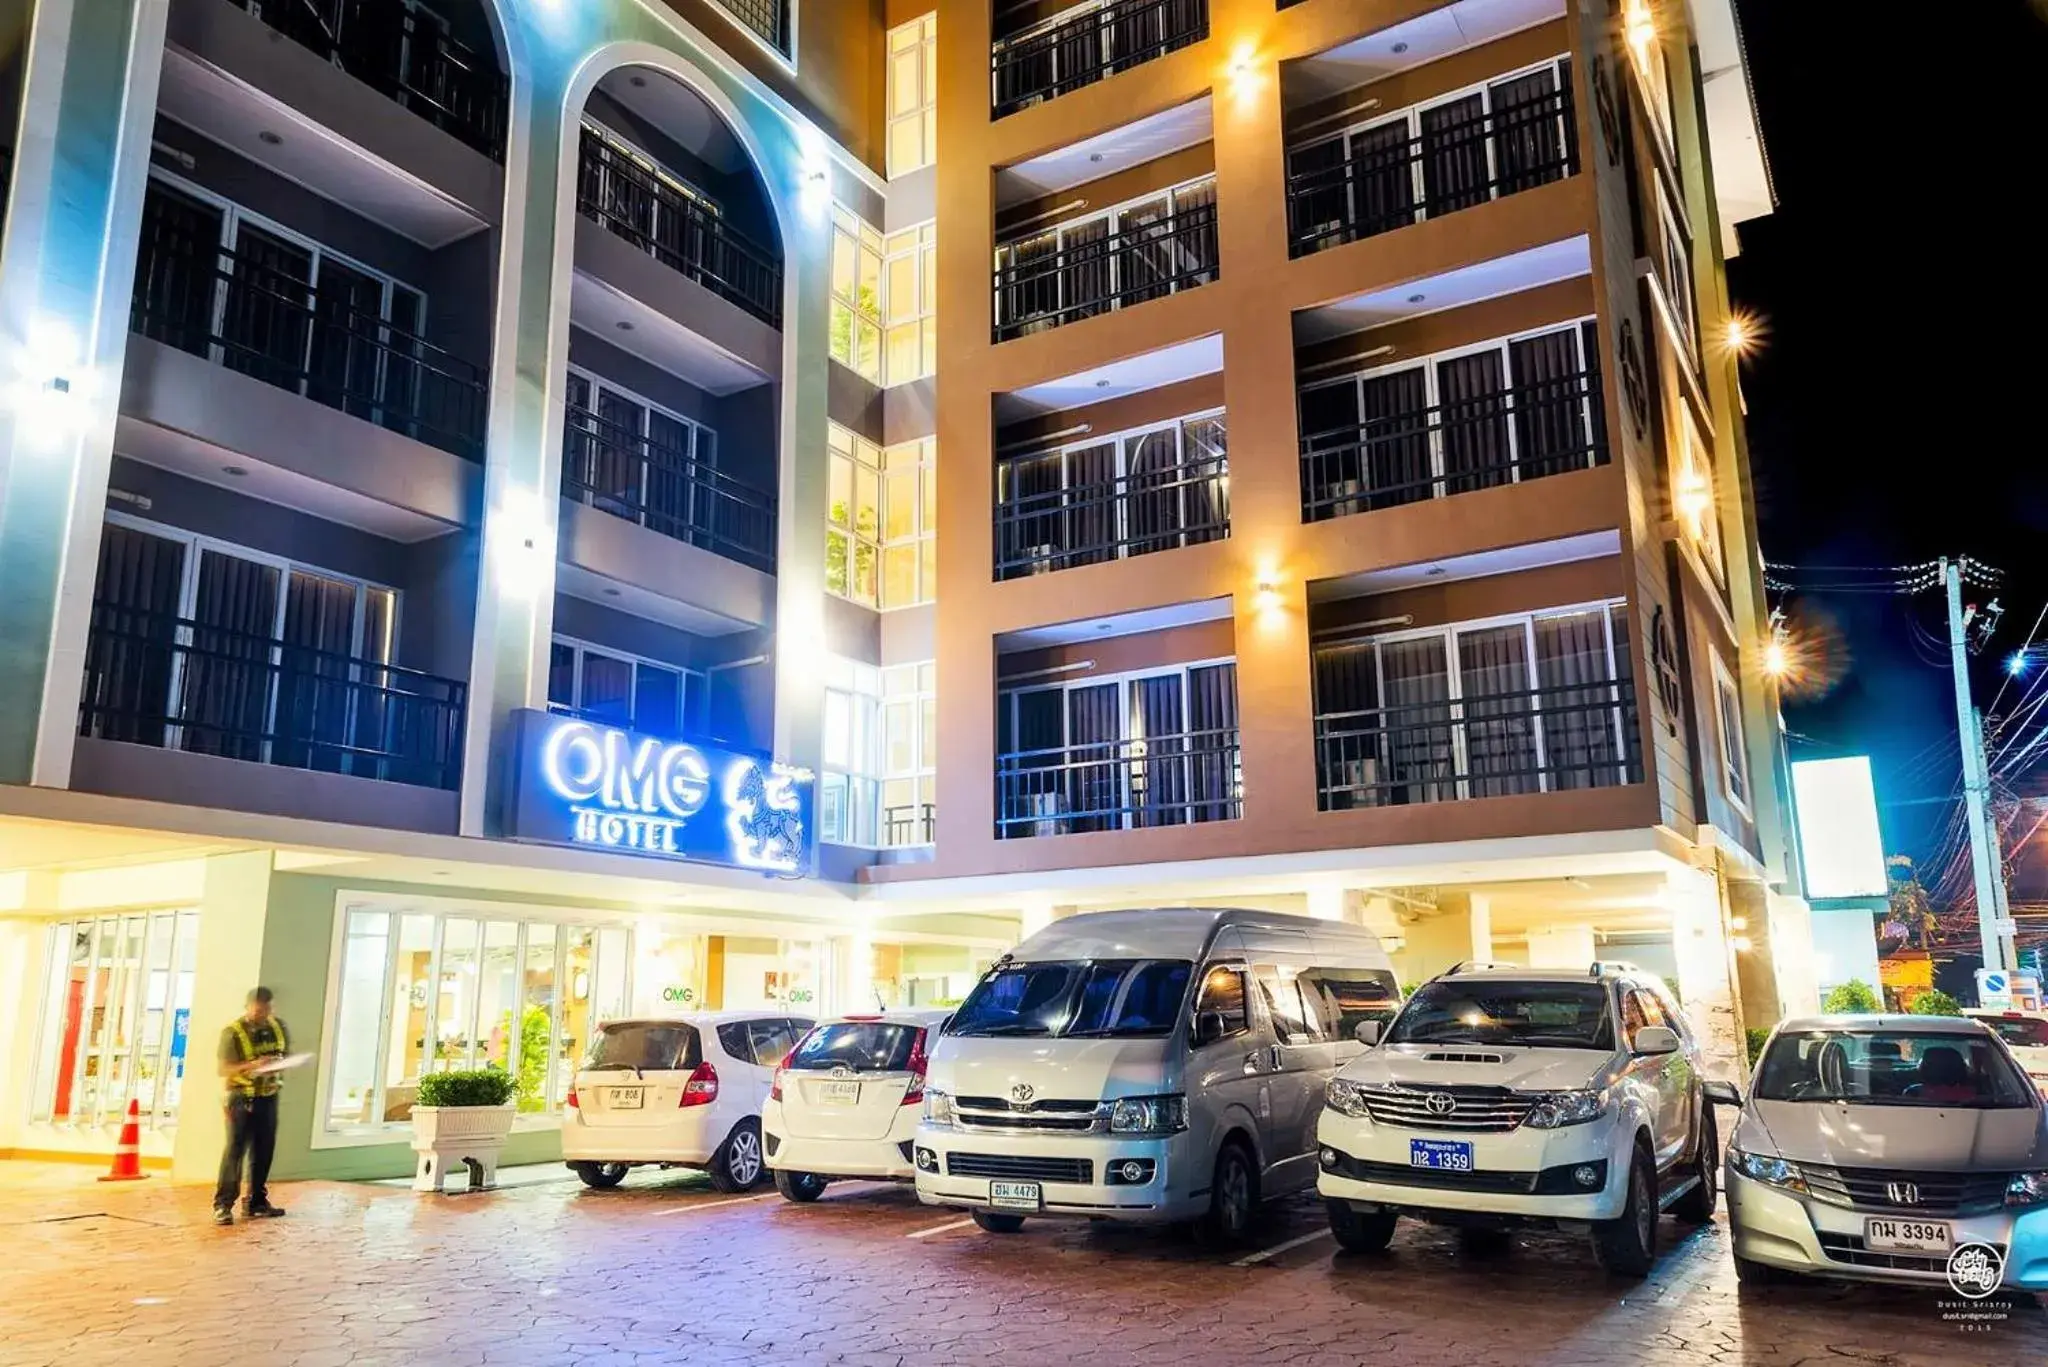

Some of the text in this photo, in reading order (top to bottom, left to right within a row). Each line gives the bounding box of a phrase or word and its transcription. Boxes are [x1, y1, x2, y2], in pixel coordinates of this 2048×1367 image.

[547, 722, 710, 817] OMG
[574, 811, 679, 851] HOTEL
[663, 988, 693, 1001] OMG
[789, 990, 813, 1002] OMG
[1436, 1152, 1468, 1169] 1359
[1013, 1185, 1037, 1197] 4479
[1903, 1224, 1945, 1241] 3394
